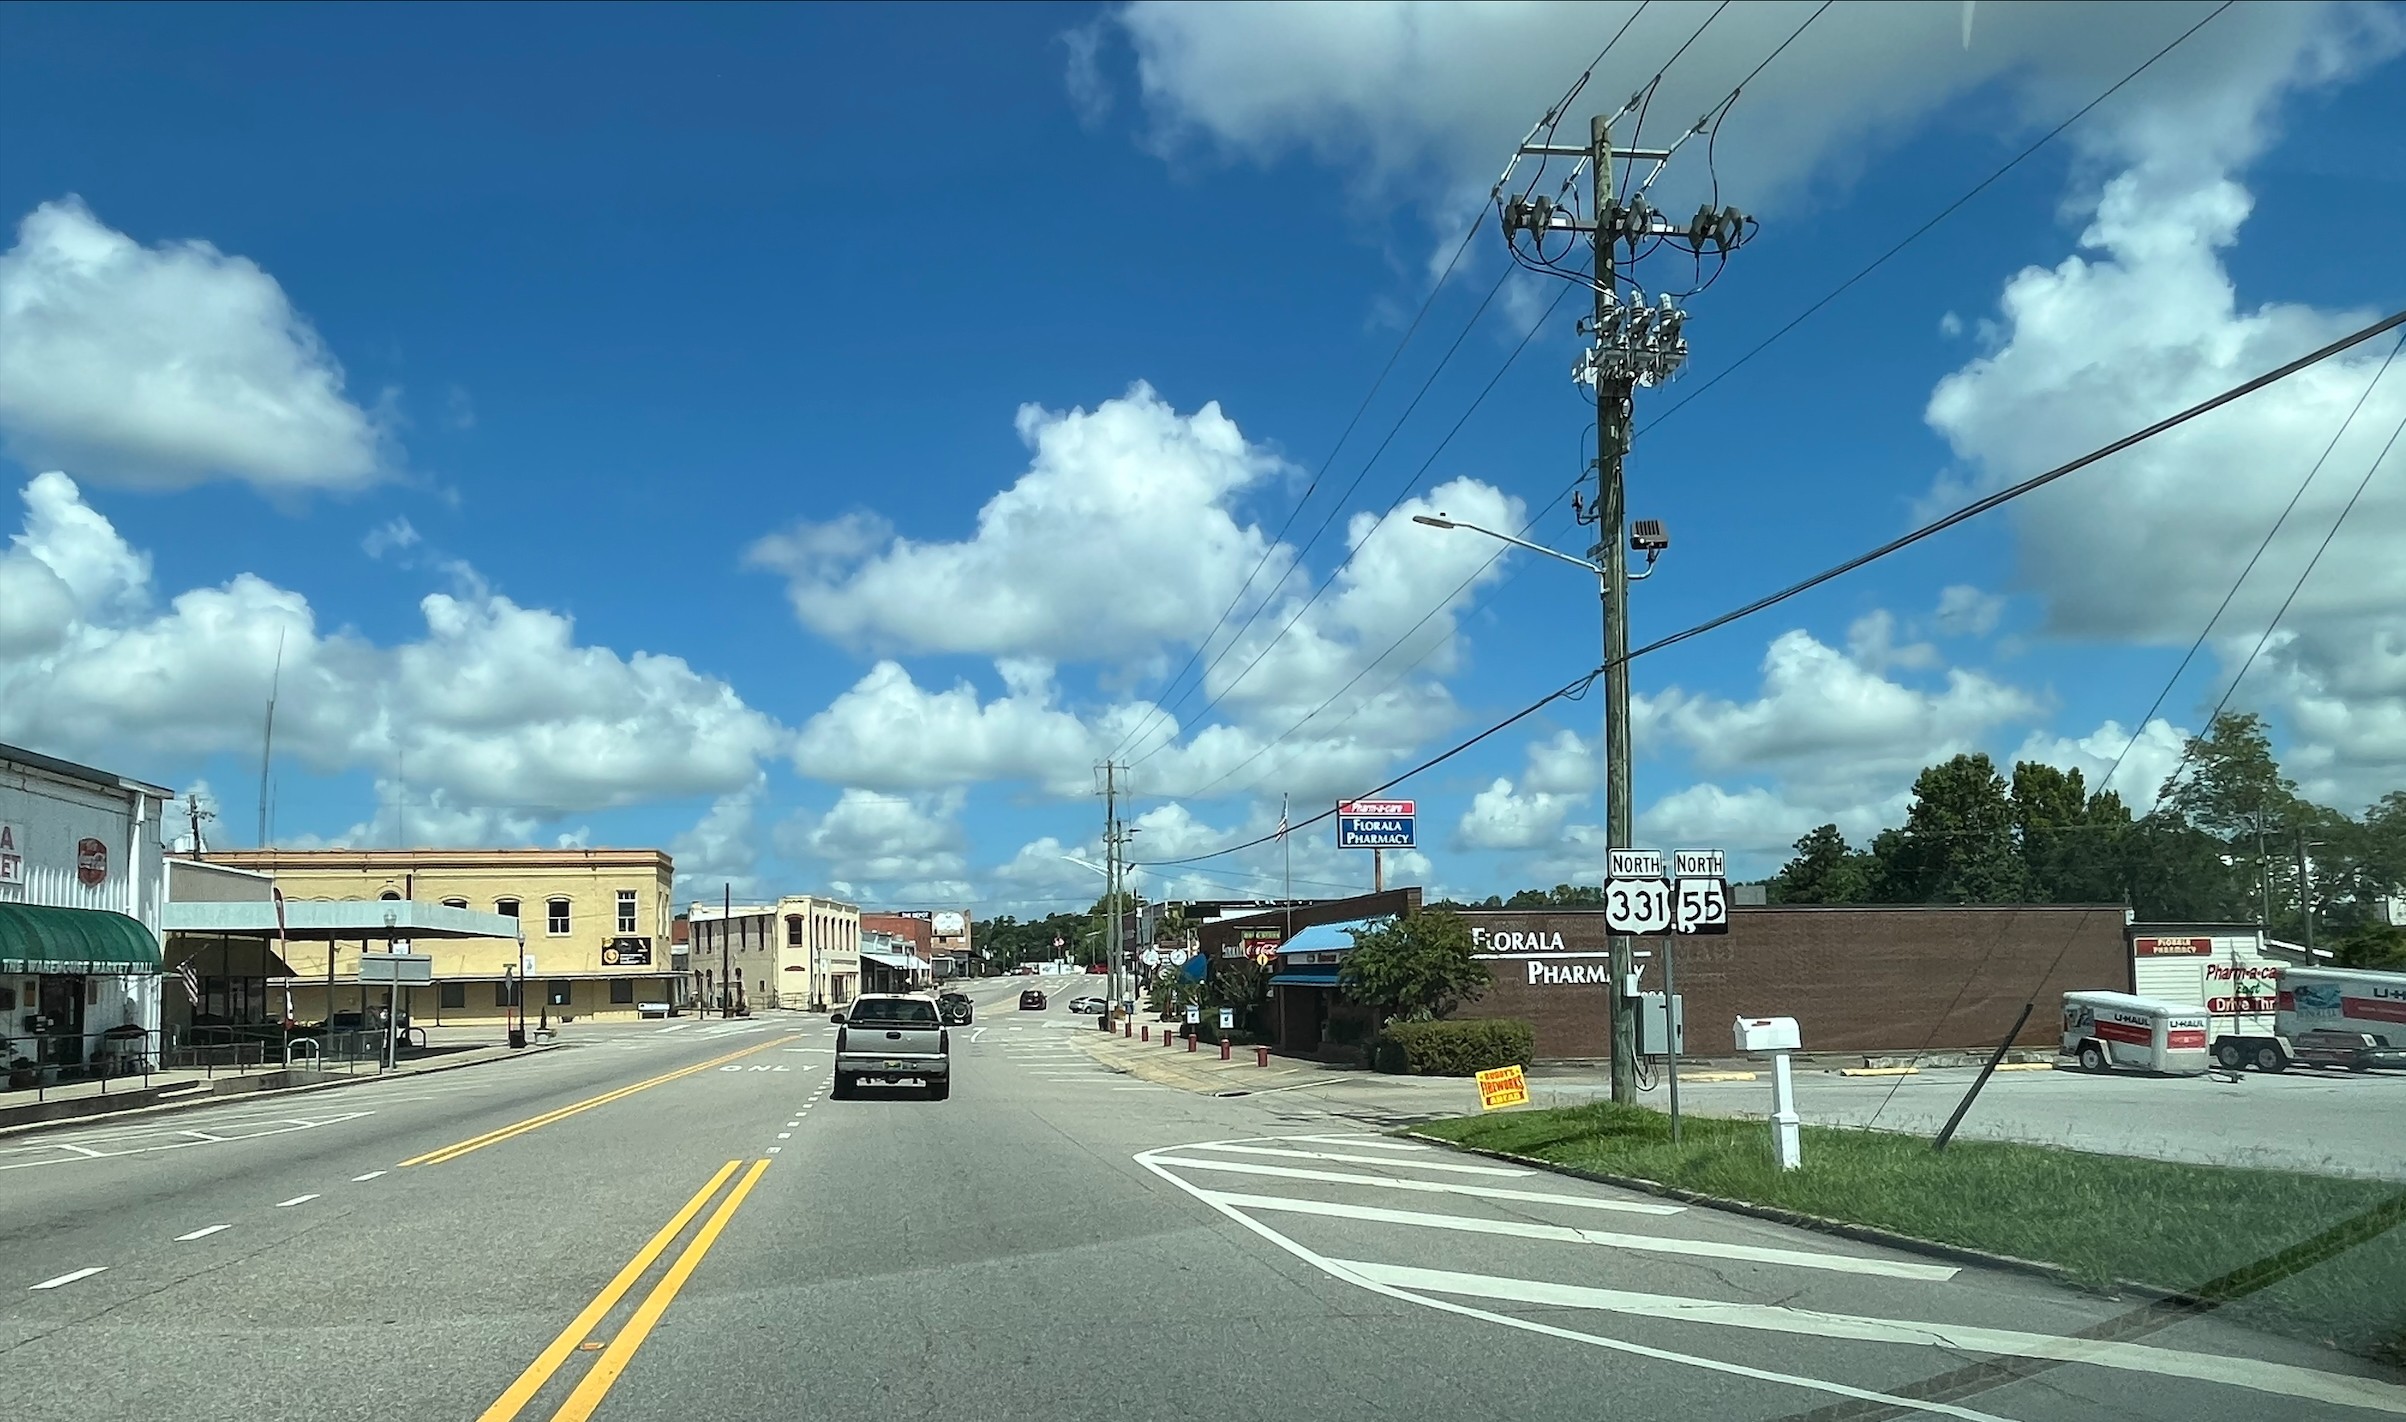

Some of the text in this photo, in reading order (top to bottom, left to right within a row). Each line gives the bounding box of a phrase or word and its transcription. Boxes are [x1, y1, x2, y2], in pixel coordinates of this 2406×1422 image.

[1353, 819, 1402, 832] FLORALA
[1346, 832, 1409, 845] PHARMACY
[1613, 855, 1660, 873] NORTH
[1677, 854, 1722, 873] NORTH
[1612, 890, 1663, 922] 331
[1683, 891, 1722, 922] 55
[1471, 927, 1565, 951] FLORALA
[1528, 961, 1645, 985] PHARMY
[2216, 998, 2250, 1012] Drive
[2114, 1013, 2150, 1026] U-HAUL
[2169, 1020, 2204, 1028] U-HAUL
[719, 1064, 820, 1072] ONLY
[1480, 1075, 1524, 1097] FIREWORKS
